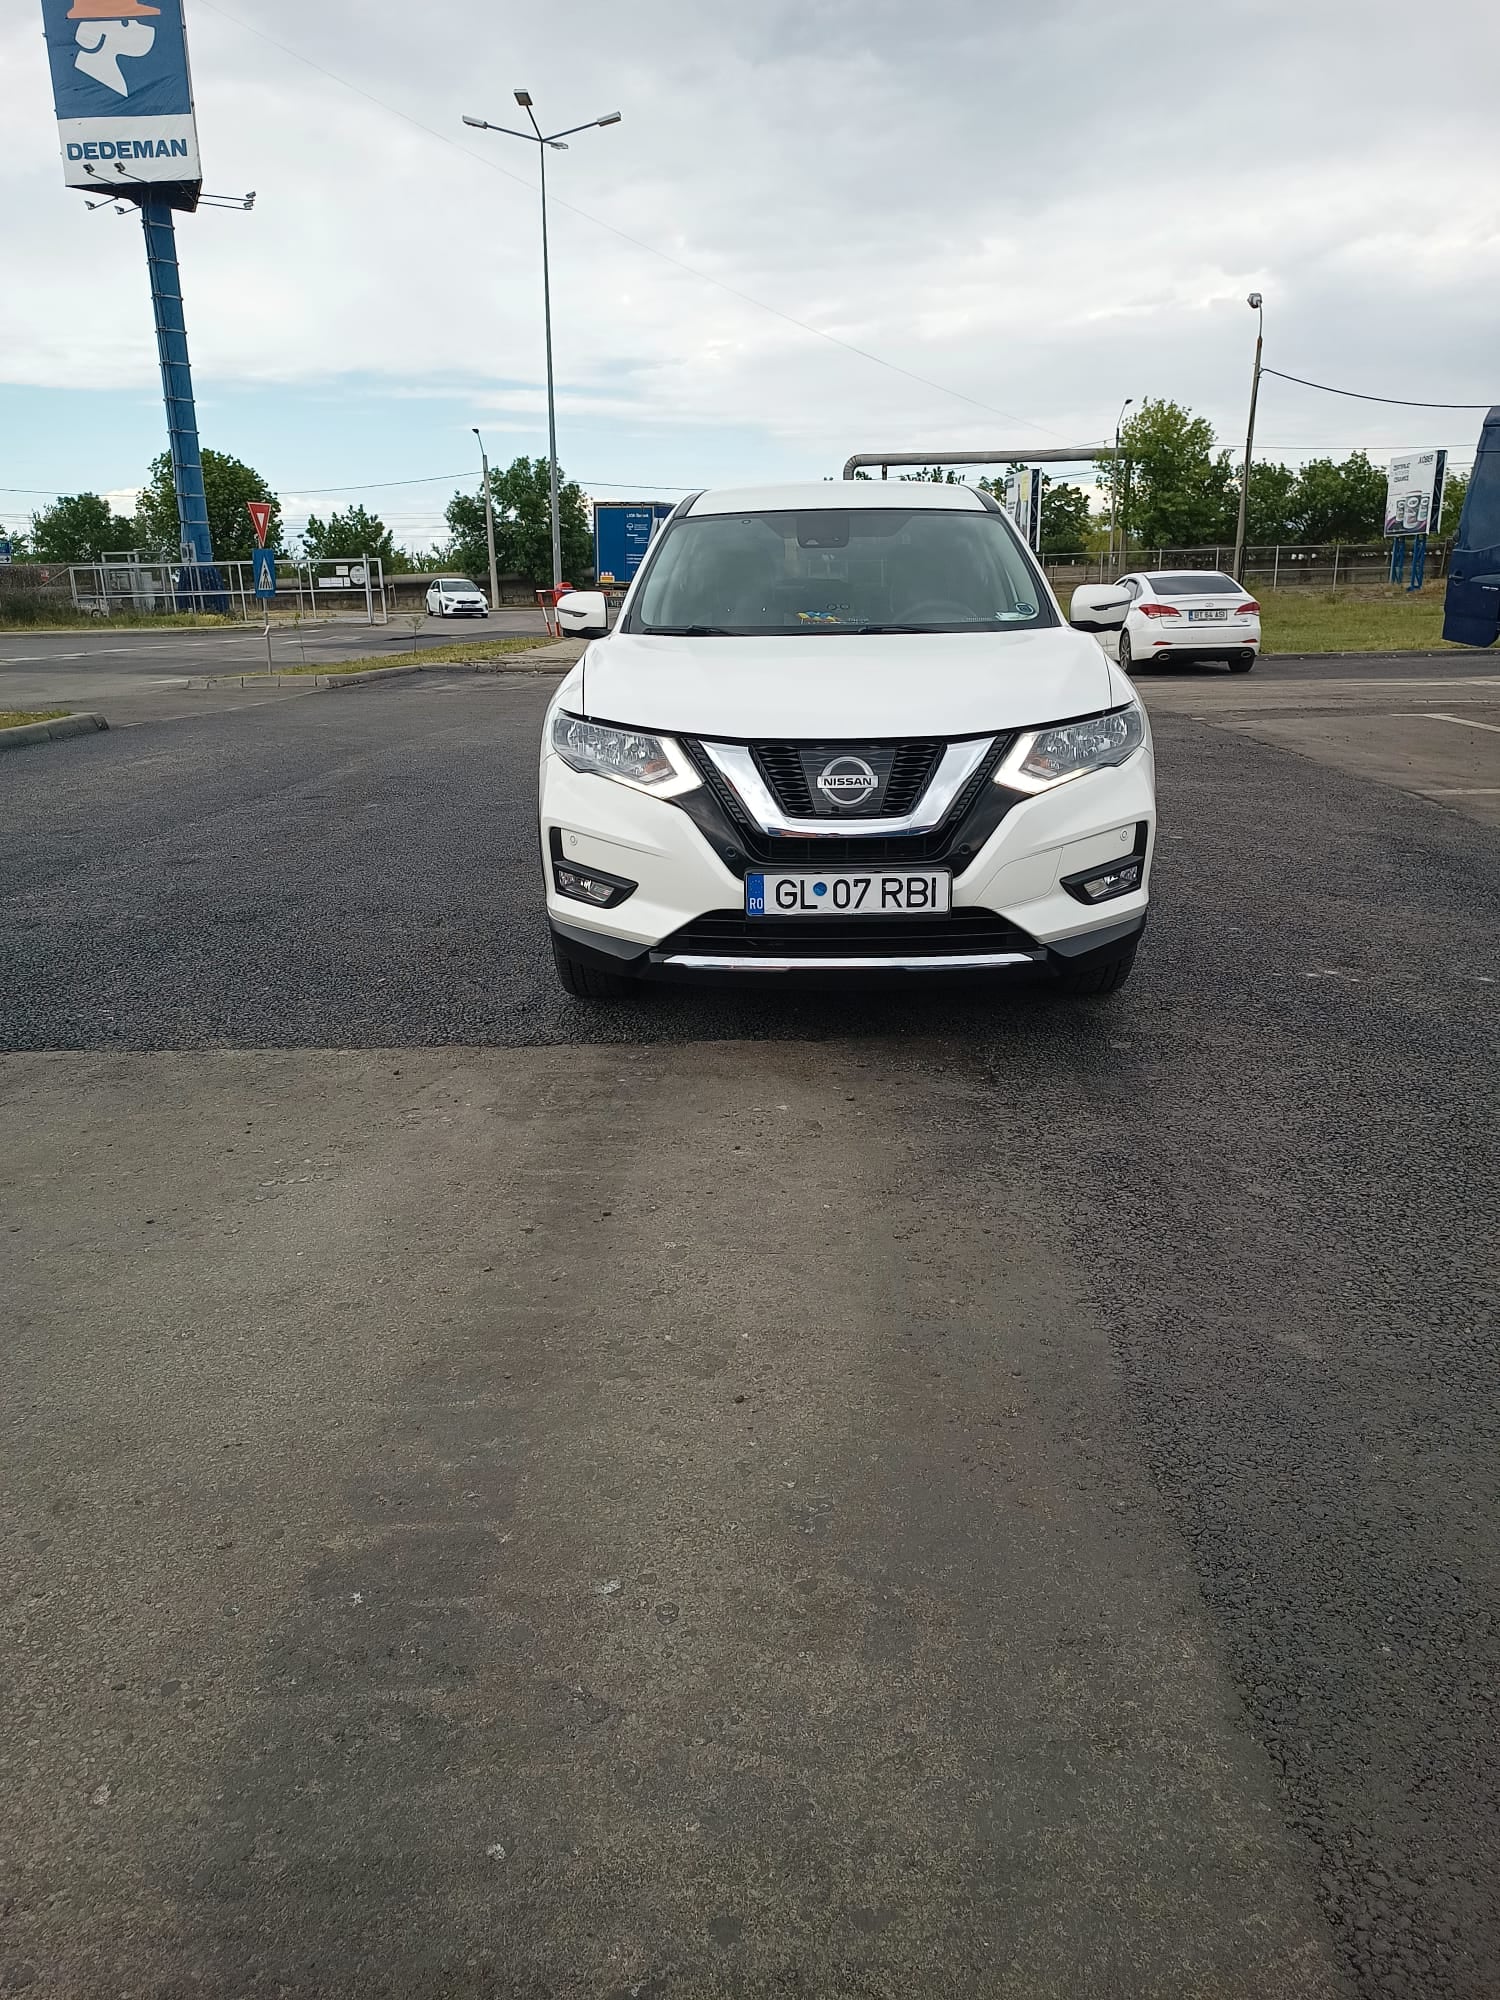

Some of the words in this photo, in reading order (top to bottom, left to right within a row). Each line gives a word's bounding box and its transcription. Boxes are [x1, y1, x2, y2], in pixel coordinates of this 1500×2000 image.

[66, 139, 188, 160] DEDEMAN
[823, 777, 872, 786] NISSAN
[750, 898, 763, 910] RO
[775, 879, 818, 910] GL
[833, 878, 872, 909] 07
[881, 877, 936, 908] RBI
